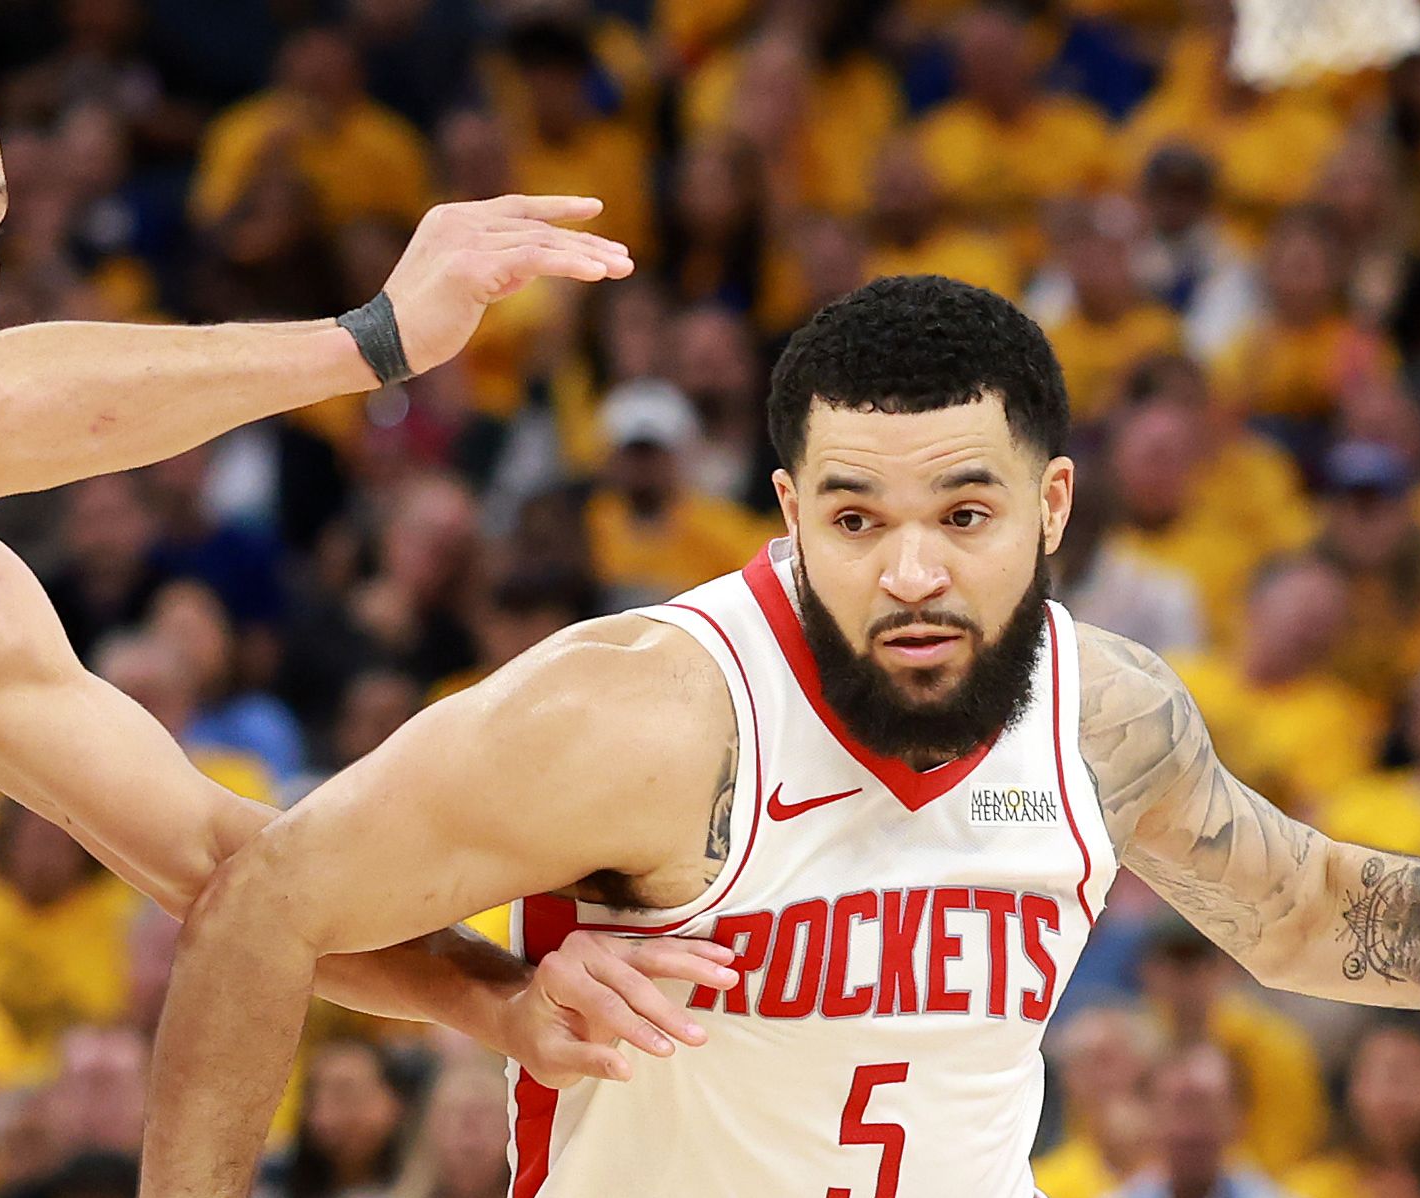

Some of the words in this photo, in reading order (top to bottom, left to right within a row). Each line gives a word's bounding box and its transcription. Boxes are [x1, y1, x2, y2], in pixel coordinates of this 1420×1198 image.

[971, 789, 1057, 808] MEMORIAL
[971, 803, 1058, 822] HERMANN
[685, 885, 1062, 1025] ROCKETS
